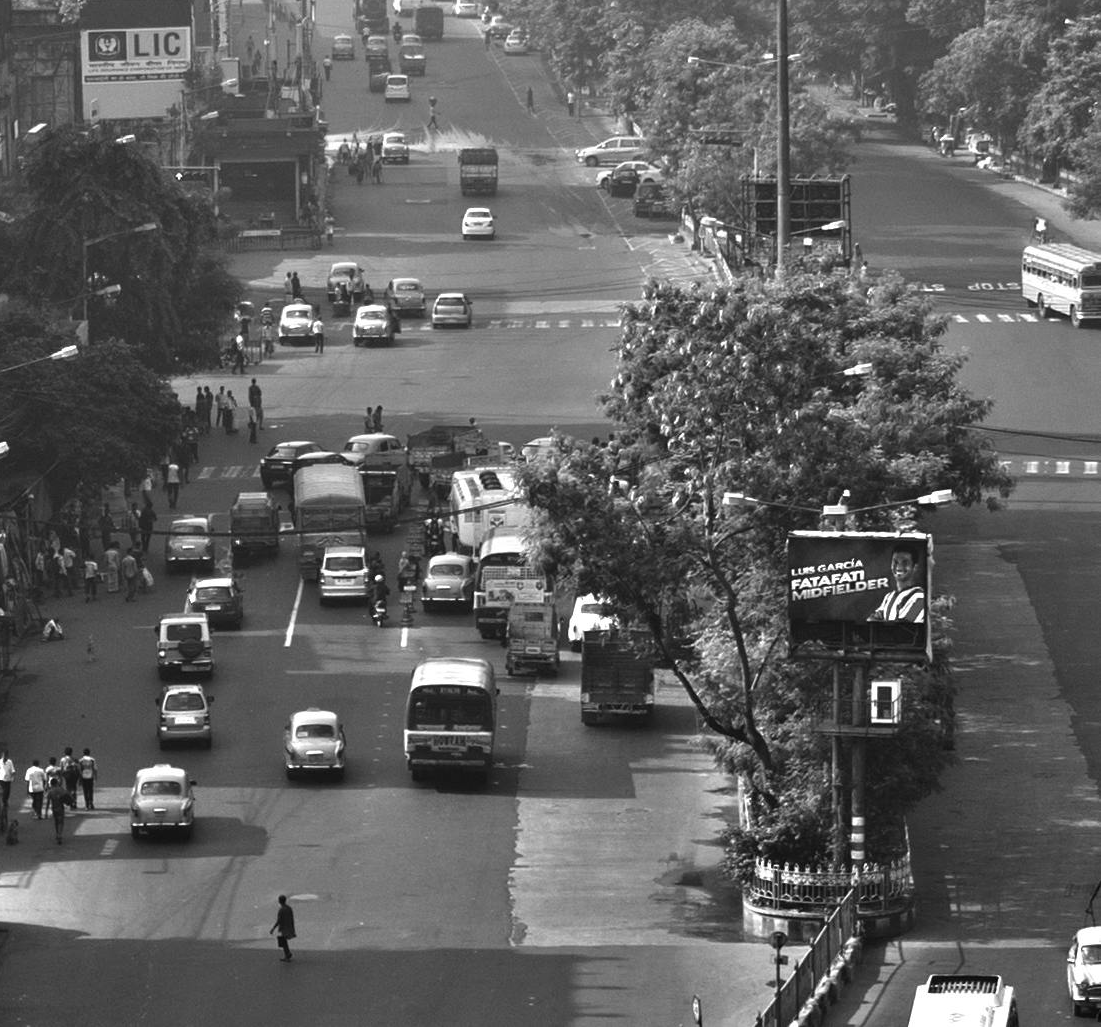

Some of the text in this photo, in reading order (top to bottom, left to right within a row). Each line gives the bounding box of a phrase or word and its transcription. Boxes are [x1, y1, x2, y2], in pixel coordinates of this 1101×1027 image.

[134, 32, 181, 56] LIC
[967, 282, 1021, 291] STOP
[791, 565, 816, 576] LUIS
[791, 570, 865, 590] FATAFATI
[791, 577, 889, 601] MIDFIELDER
